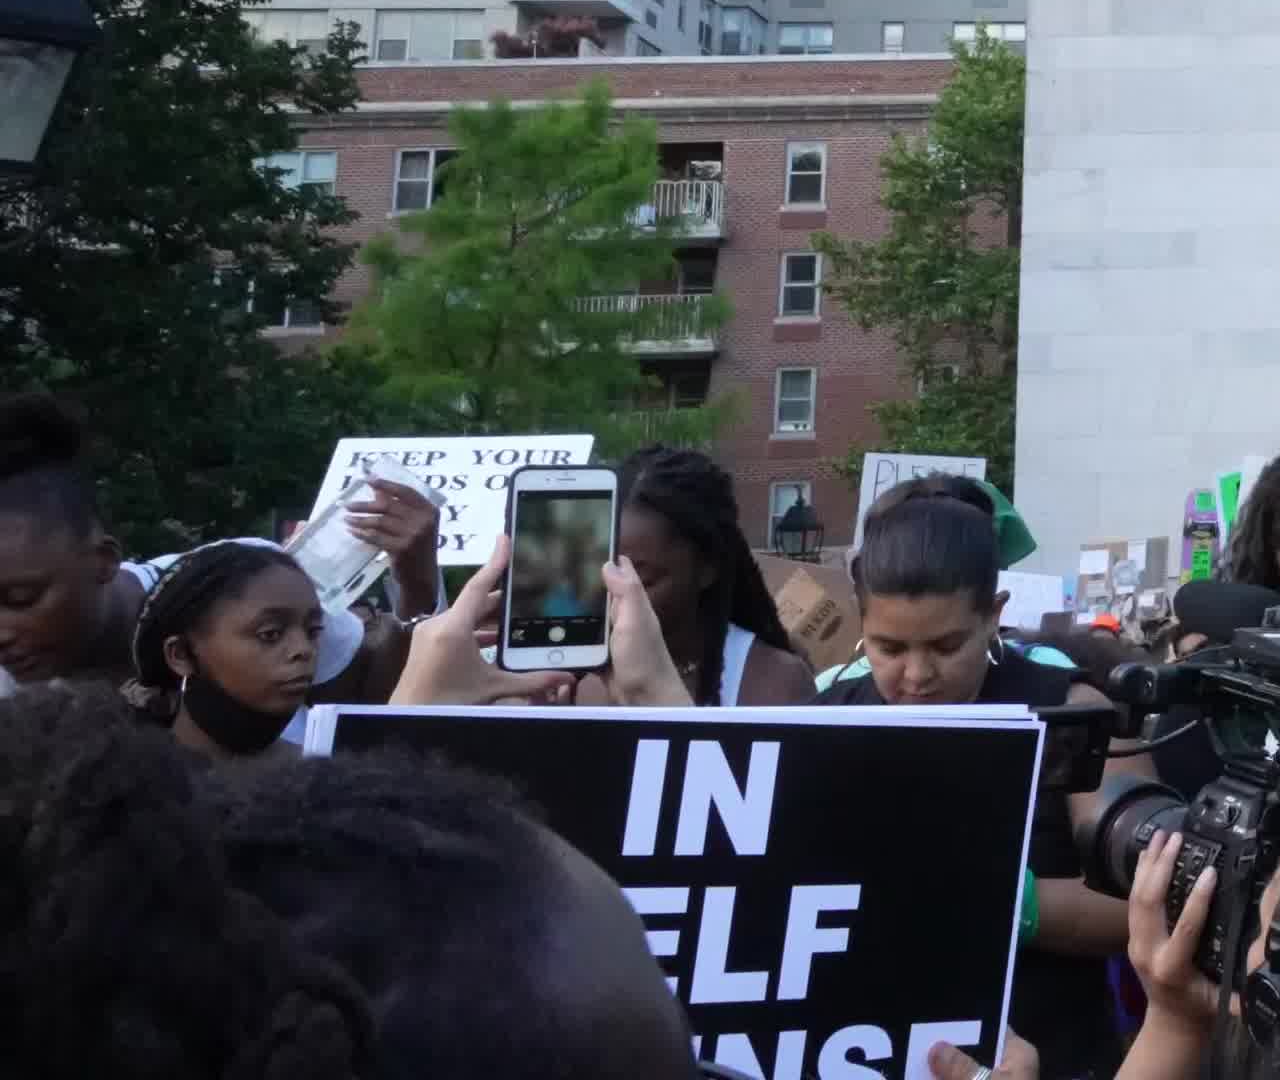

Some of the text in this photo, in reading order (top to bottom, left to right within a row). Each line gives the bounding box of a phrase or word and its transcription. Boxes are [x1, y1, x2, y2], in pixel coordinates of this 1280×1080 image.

[350, 448, 573, 468] KEP YOUR
[620, 738, 782, 857] IN
